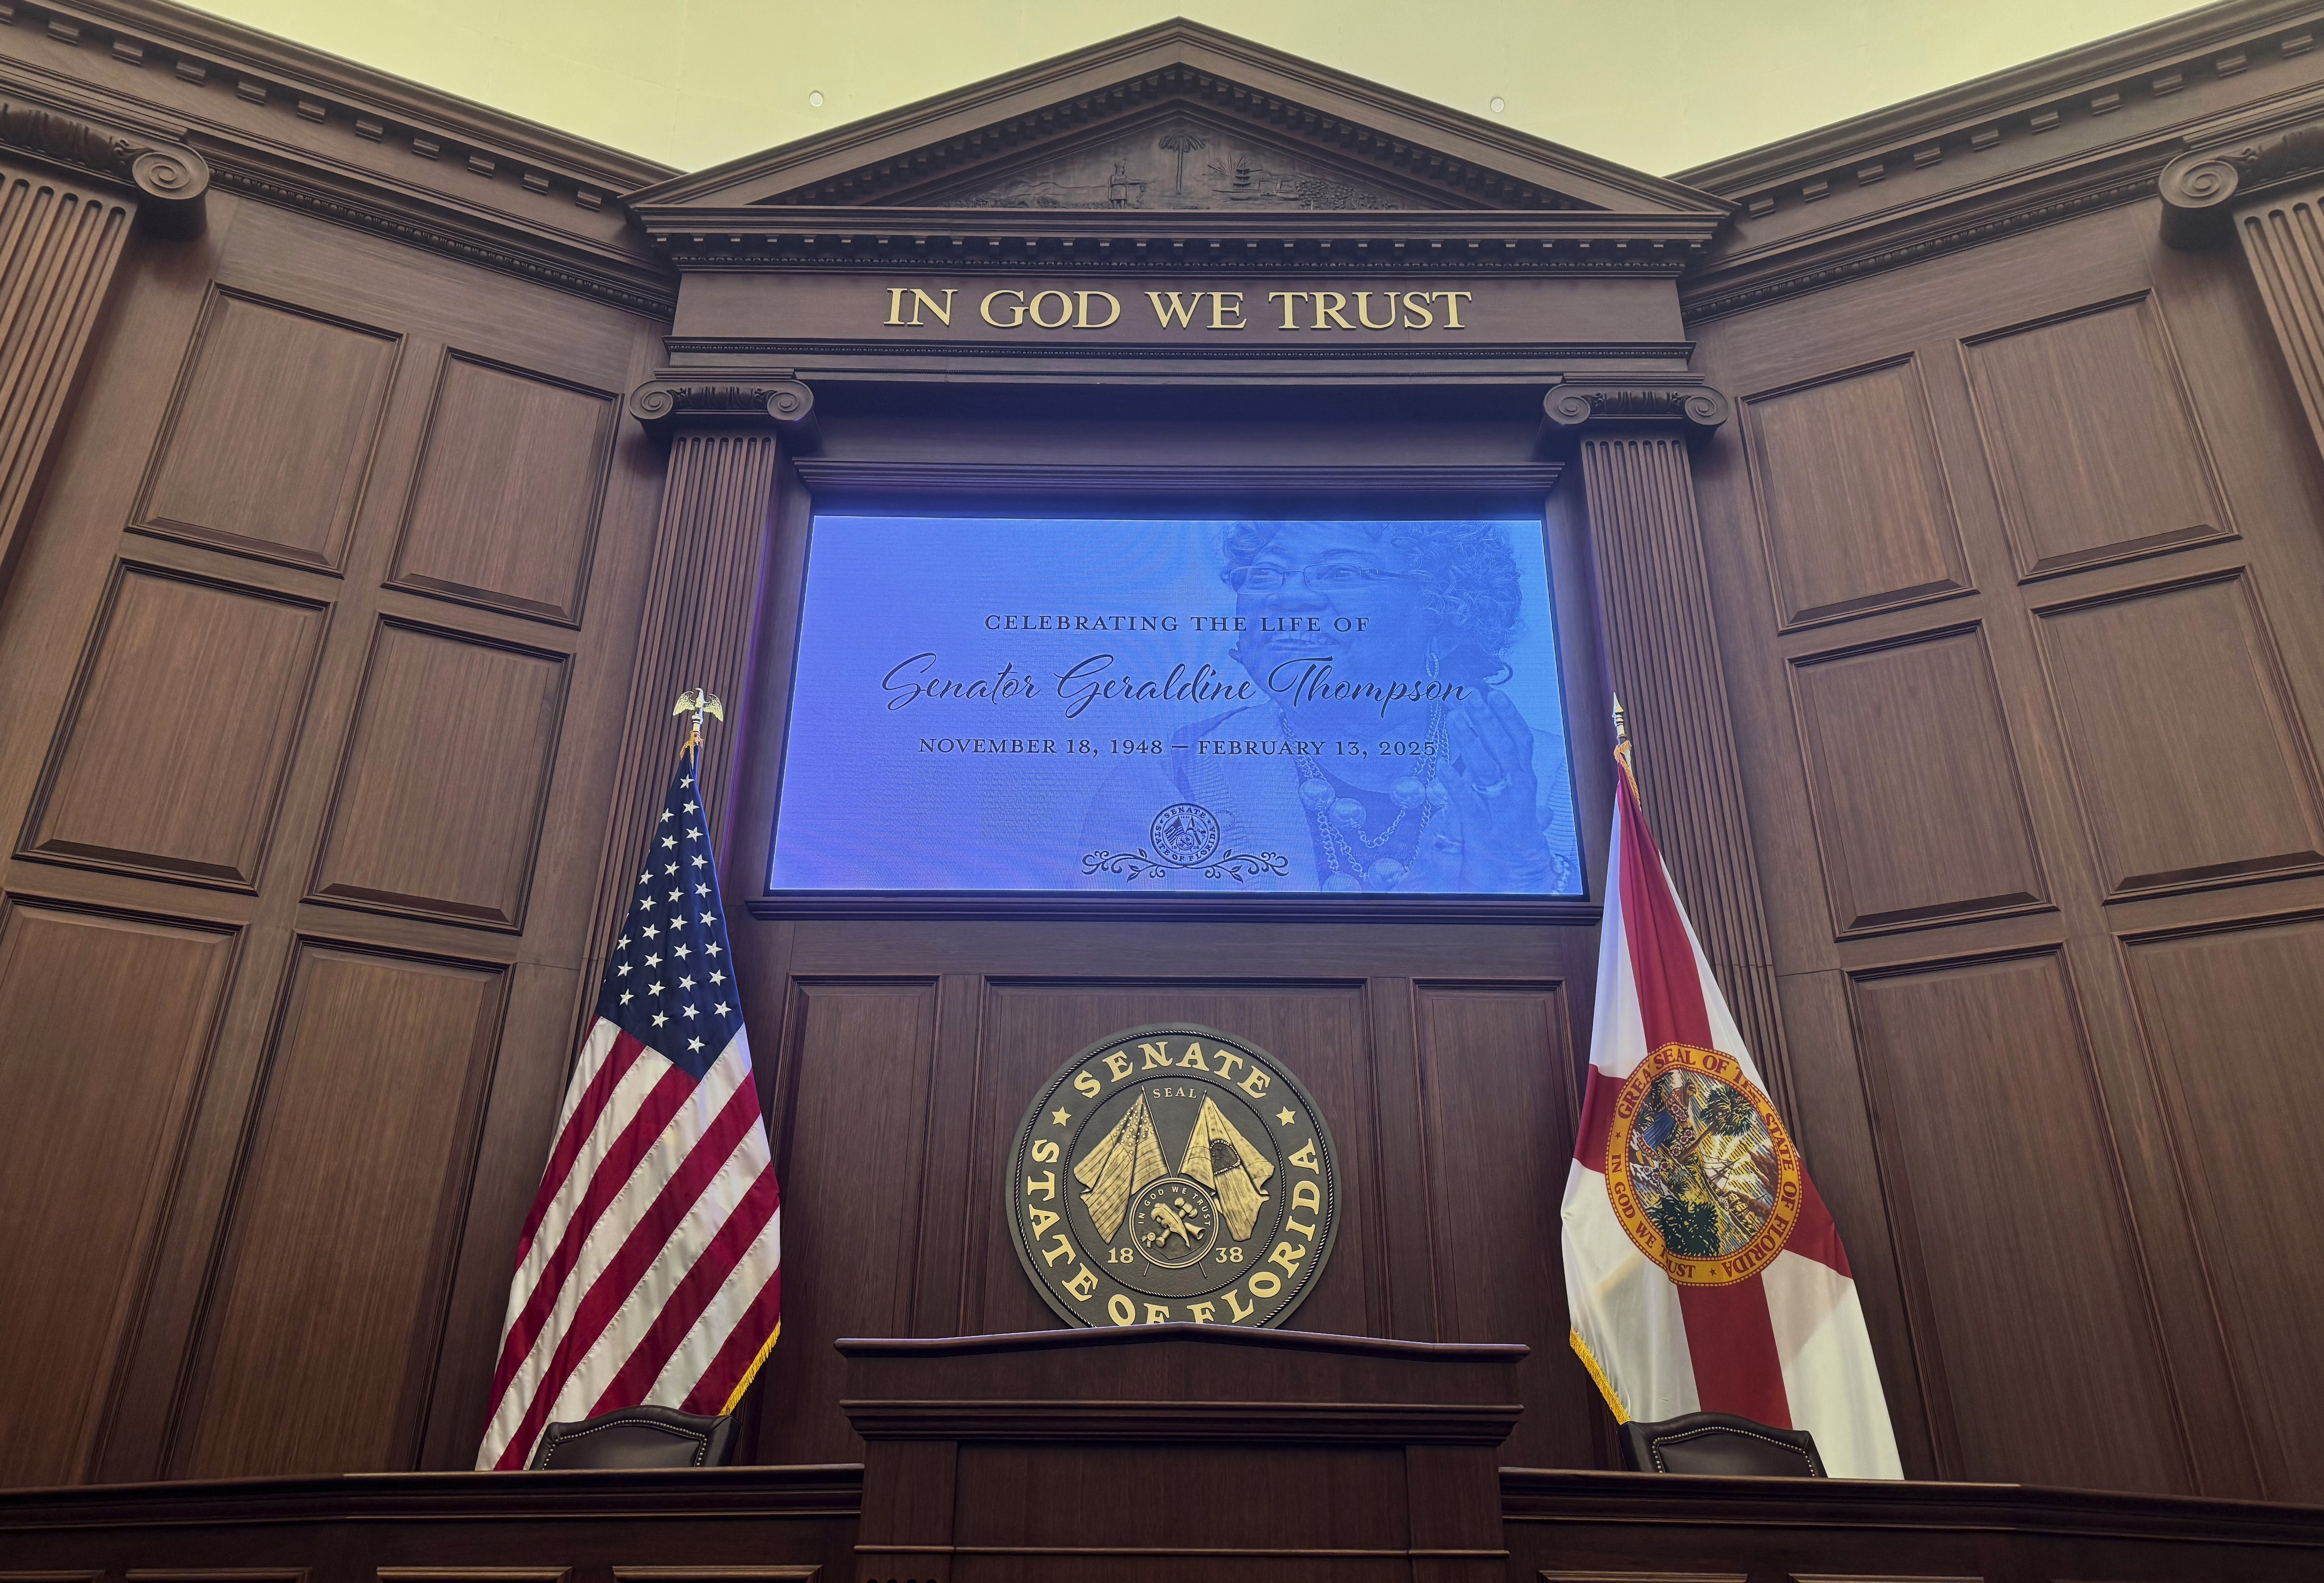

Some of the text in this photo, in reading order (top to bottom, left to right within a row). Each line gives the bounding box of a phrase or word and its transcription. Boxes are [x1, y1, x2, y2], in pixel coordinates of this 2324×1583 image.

[883, 288, 1472, 330] IN GOD WE TRUST
[985, 614, 1370, 632] CELEBRATING THE LIFE OF
[882, 652, 1472, 719] Senator Geraldine Thompson
[918, 738, 1057, 754] NOVEMBER
[1066, 739, 1099, 758] 18,
[1111, 739, 1163, 755] 1948
[1198, 740, 1326, 756] FEBRUARY
[1336, 741, 1368, 759] 13,
[1378, 741, 1436, 757] 2025
[1164, 807, 1206, 818] SENATE
[1155, 826, 1170, 855] STATE
[1189, 826, 1216, 862] FLORIDA
[1073, 1041, 1271, 1099] SENATE
[1653, 1048, 1696, 1069] SEAL
[1703, 1055, 1730, 1074] OF
[1153, 1087, 1197, 1099] SEAL
[1618, 1060, 1651, 1119] GREA
[1766, 1113, 1794, 1171] STATE
[1138, 1186, 1211, 1226] IN GOD WE TRUST
[1781, 1181, 1797, 1211] OF
[1027, 1138, 1320, 1326] STATE OF FLORIDA
[1612, 1153, 1696, 1278] IN GOD WE TUST
[1107, 1248, 1134, 1264] 18
[1215, 1246, 1244, 1264] 38
[1721, 1213, 1789, 1277] FLORIDA
